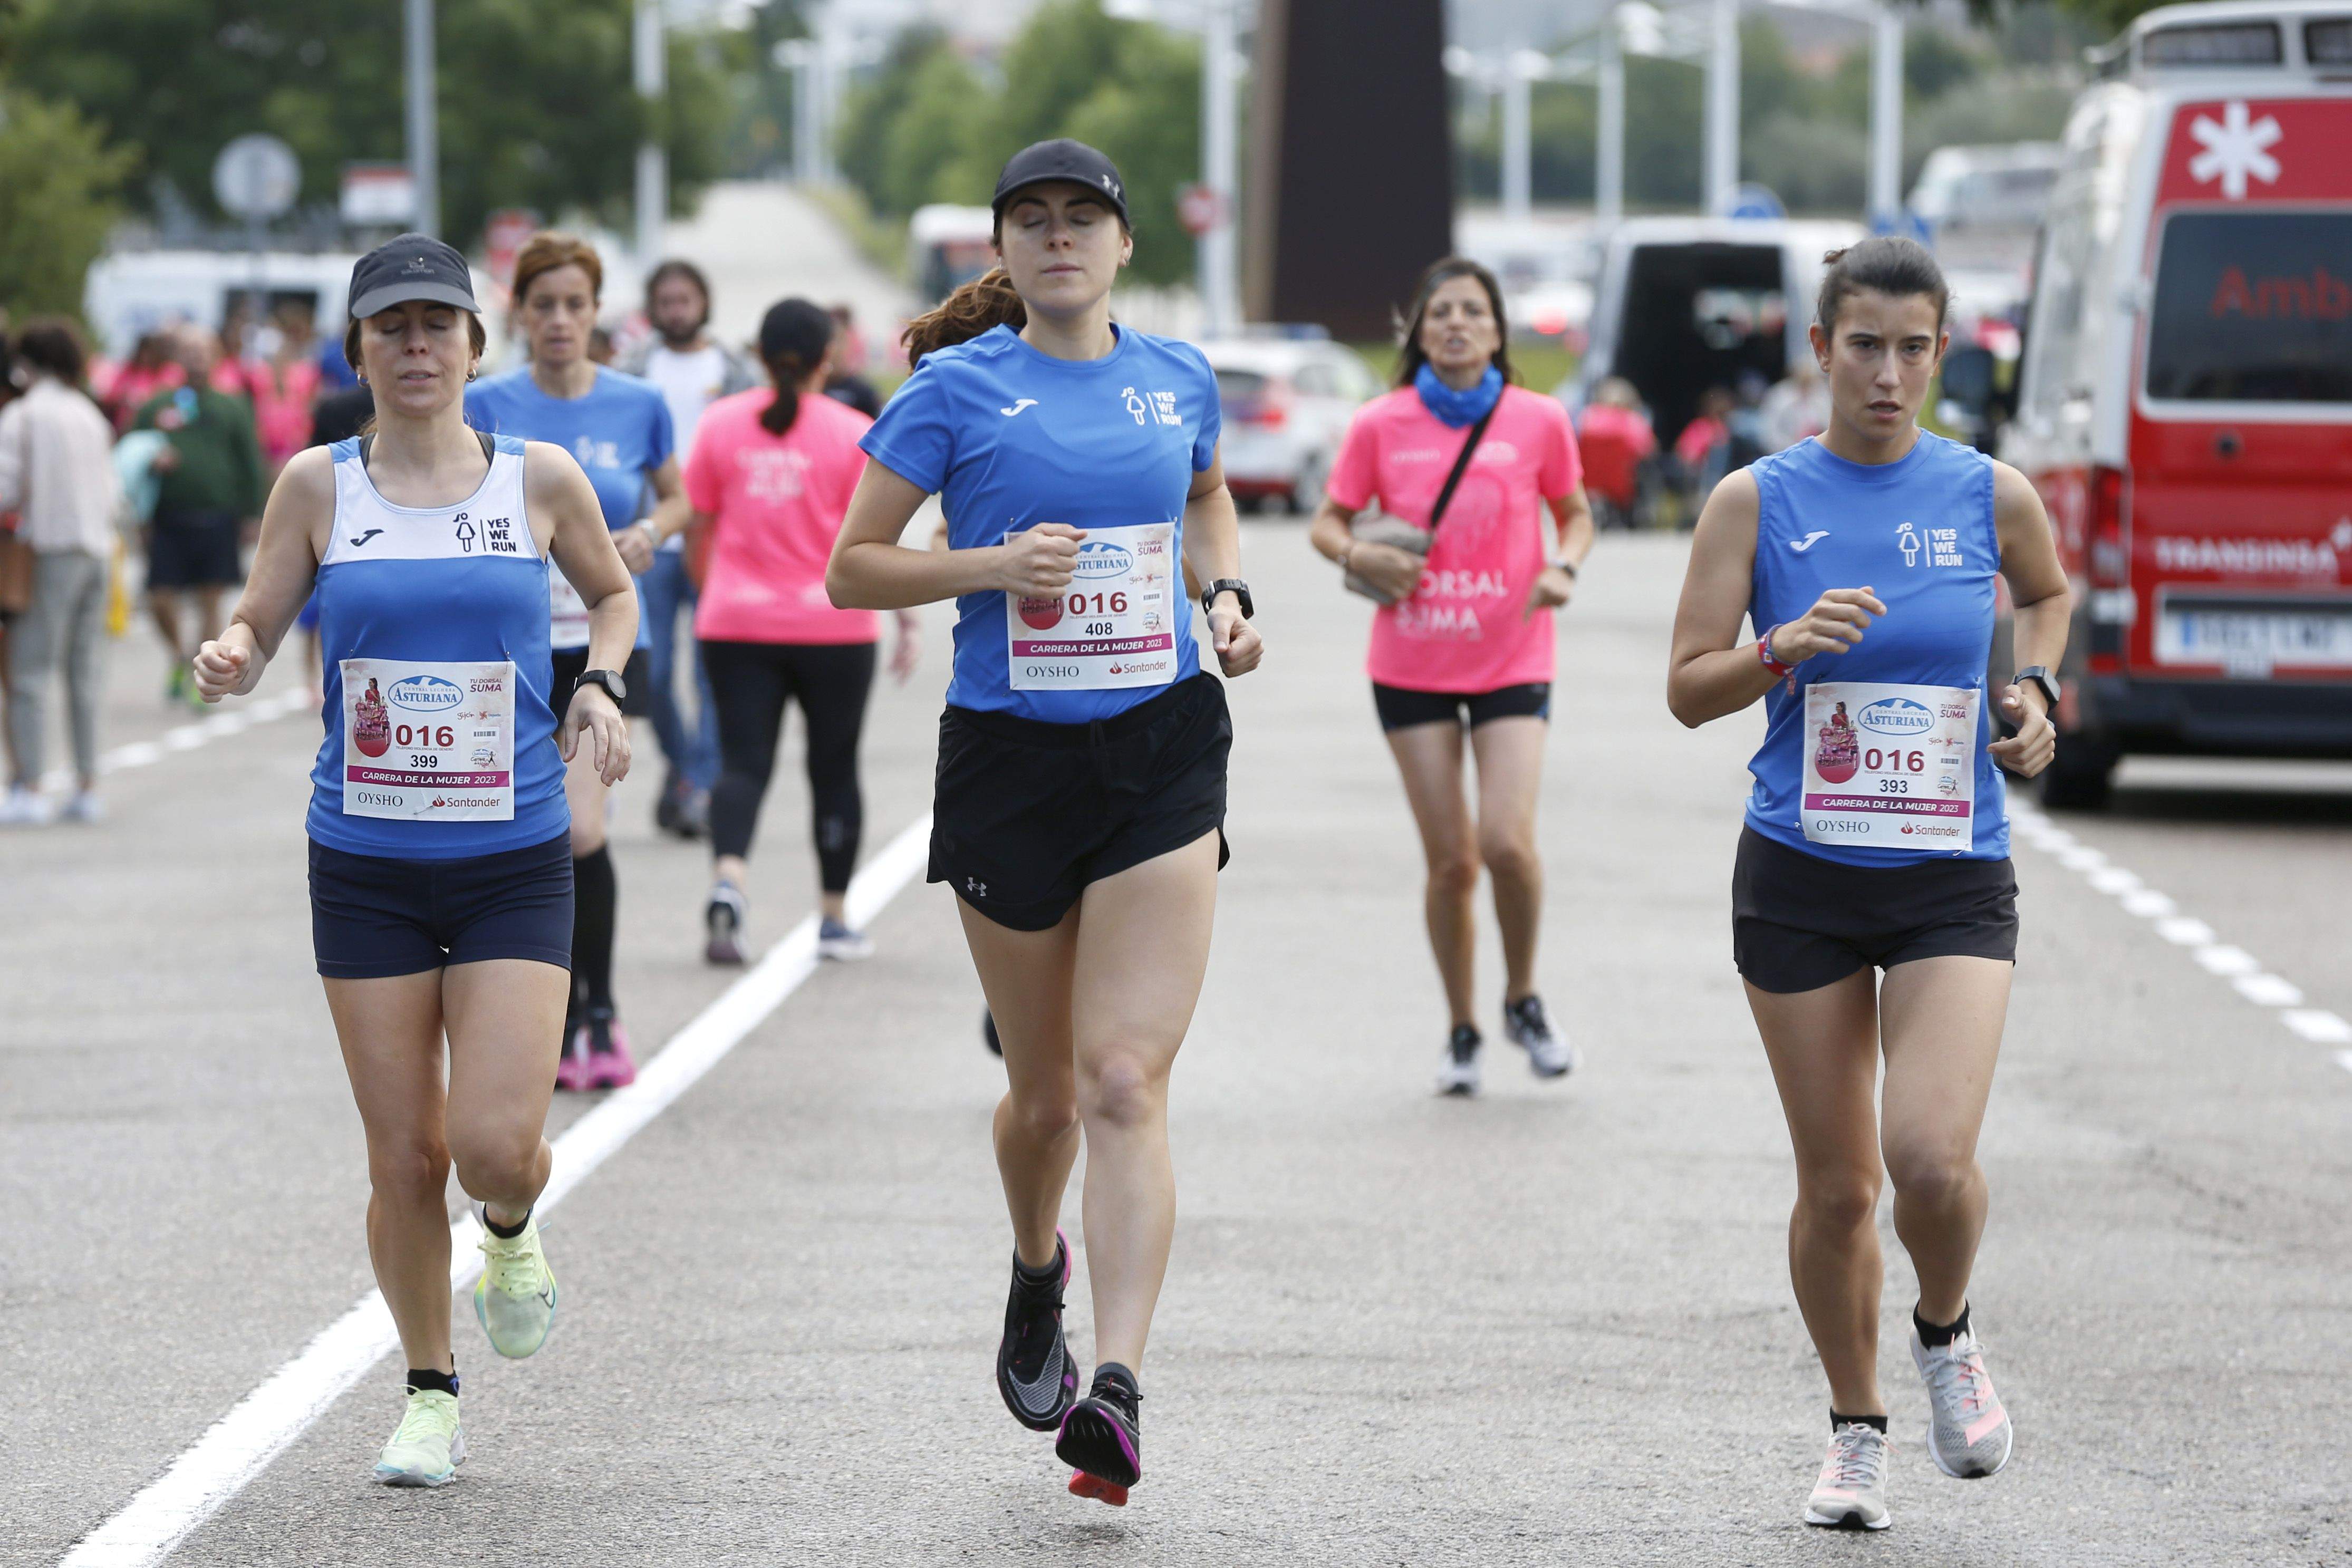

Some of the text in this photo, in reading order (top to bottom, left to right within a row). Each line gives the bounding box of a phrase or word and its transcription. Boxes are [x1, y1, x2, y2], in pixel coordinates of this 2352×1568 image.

[1153, 392, 1176, 403] YES
[1157, 402, 1174, 414] WE
[1161, 413, 1182, 427] RUN
[487, 518, 509, 529] YES
[489, 530, 509, 540] WE
[1931, 528, 1956, 540] YES
[491, 541, 516, 552] RUN
[1138, 546, 1162, 556] SUMA
[1933, 541, 1955, 553] WE
[1076, 558, 1129, 570] STURIANA
[1935, 554, 1963, 566] RUN
[1416, 569, 1509, 598] ORSAL
[1068, 592, 1128, 615] 016
[1085, 622, 1113, 636] 408
[1030, 643, 1077, 653] CARRERA
[1096, 643, 1110, 652] LA
[1112, 641, 1143, 651] MUJER
[1146, 638, 1162, 649] 2023
[1026, 665, 1079, 677] OYSHO
[1124, 660, 1167, 674] Santander
[393, 688, 457, 702] ASTURIANA
[470, 684, 502, 692] SUMA
[1864, 710, 1930, 727] ASTURIANA
[1940, 710, 1967, 719] SUMA
[396, 724, 454, 747] 016
[410, 754, 438, 768] 399
[1865, 748, 1925, 772] 016
[362, 771, 497, 785] CARRERA DE LA MUJER 2023
[1880, 779, 1908, 793] 393
[358, 792, 403, 807] OYSHO
[447, 797, 500, 808] Santander
[1823, 798, 1959, 812] CARRERA DE LA MUJER 2023
[1817, 819, 1870, 833] OYSHO
[1915, 825, 1961, 837] Santander
